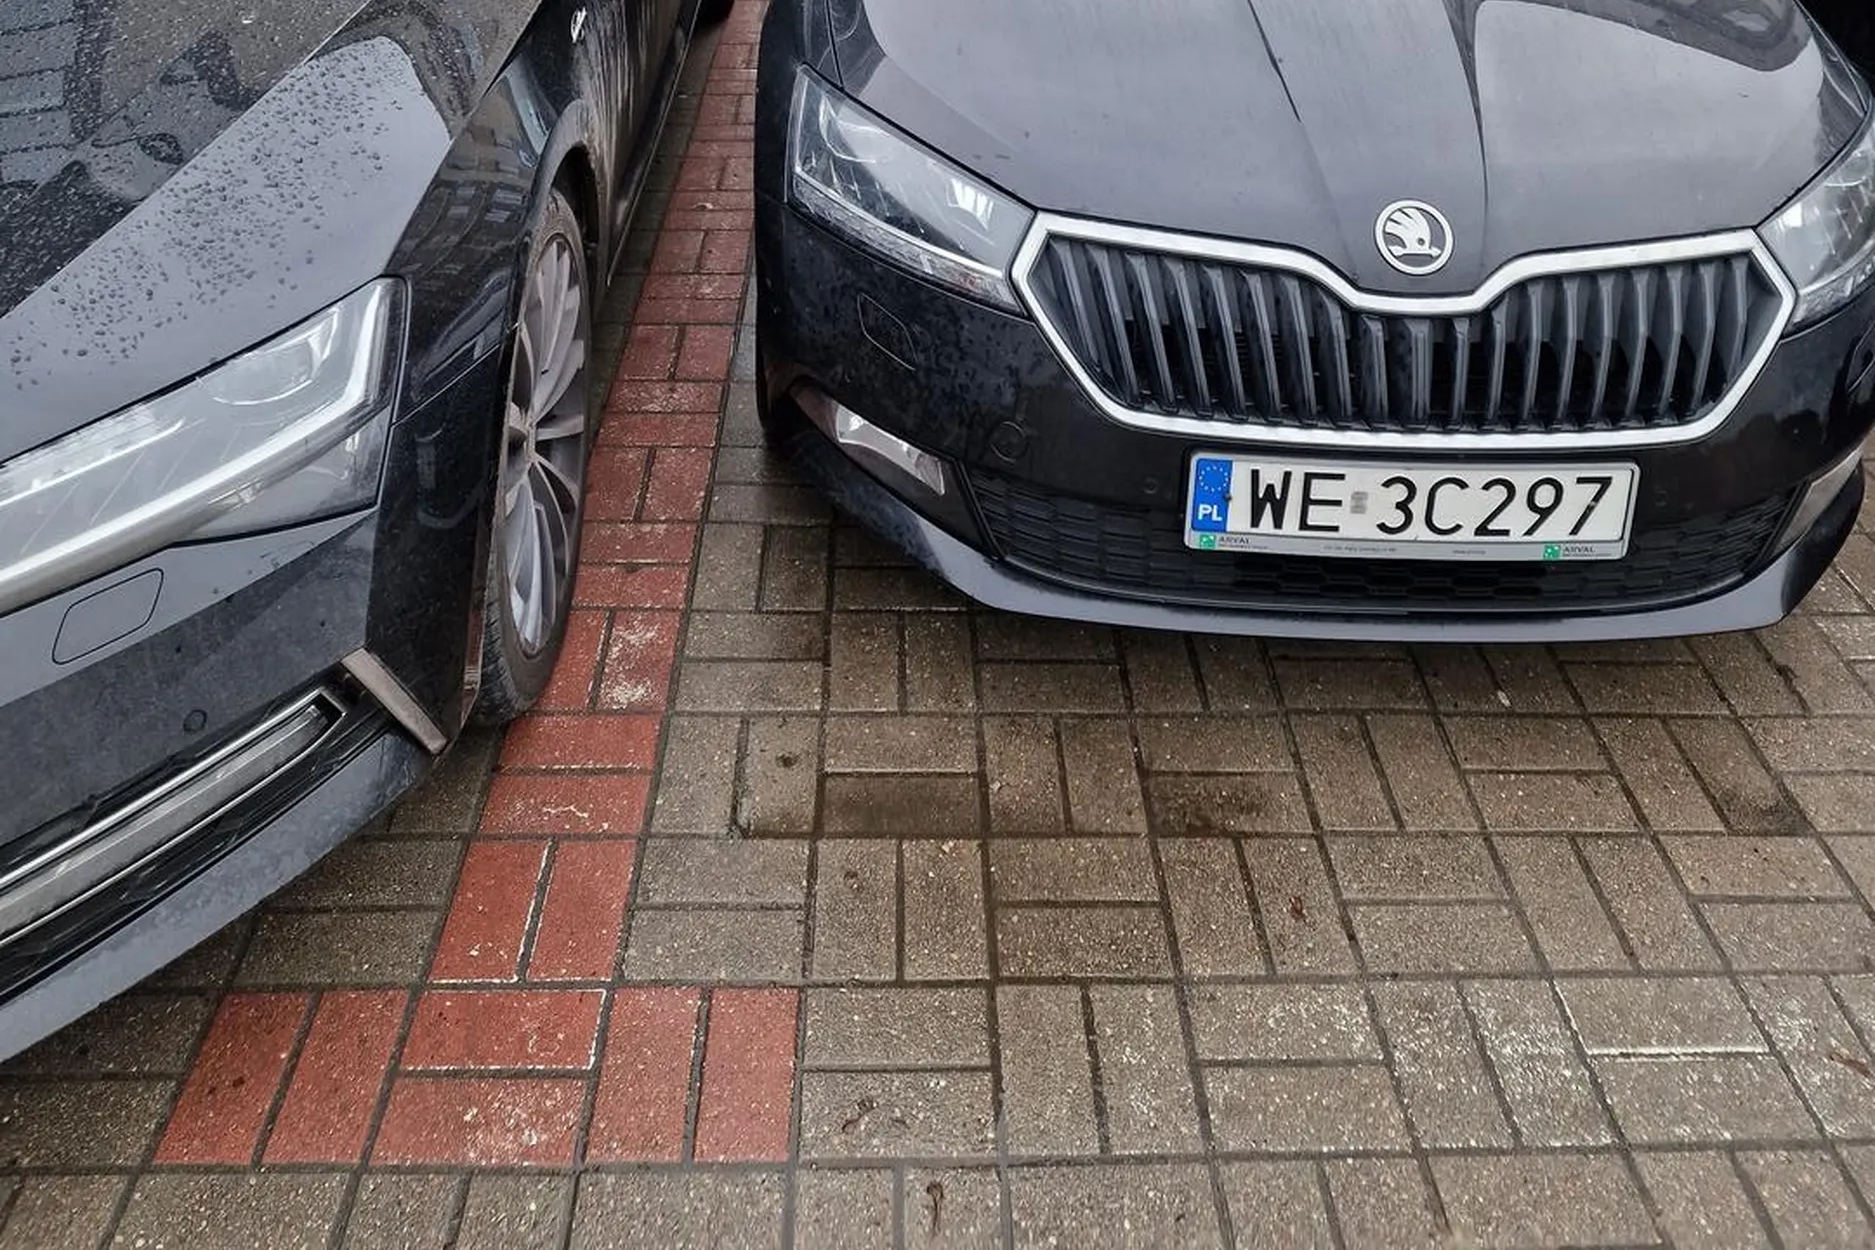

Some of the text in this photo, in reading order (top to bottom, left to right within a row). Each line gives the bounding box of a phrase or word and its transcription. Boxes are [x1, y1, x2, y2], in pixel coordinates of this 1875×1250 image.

[1197, 504, 1223, 523] PL
[1249, 468, 1614, 537] WE 3C297
